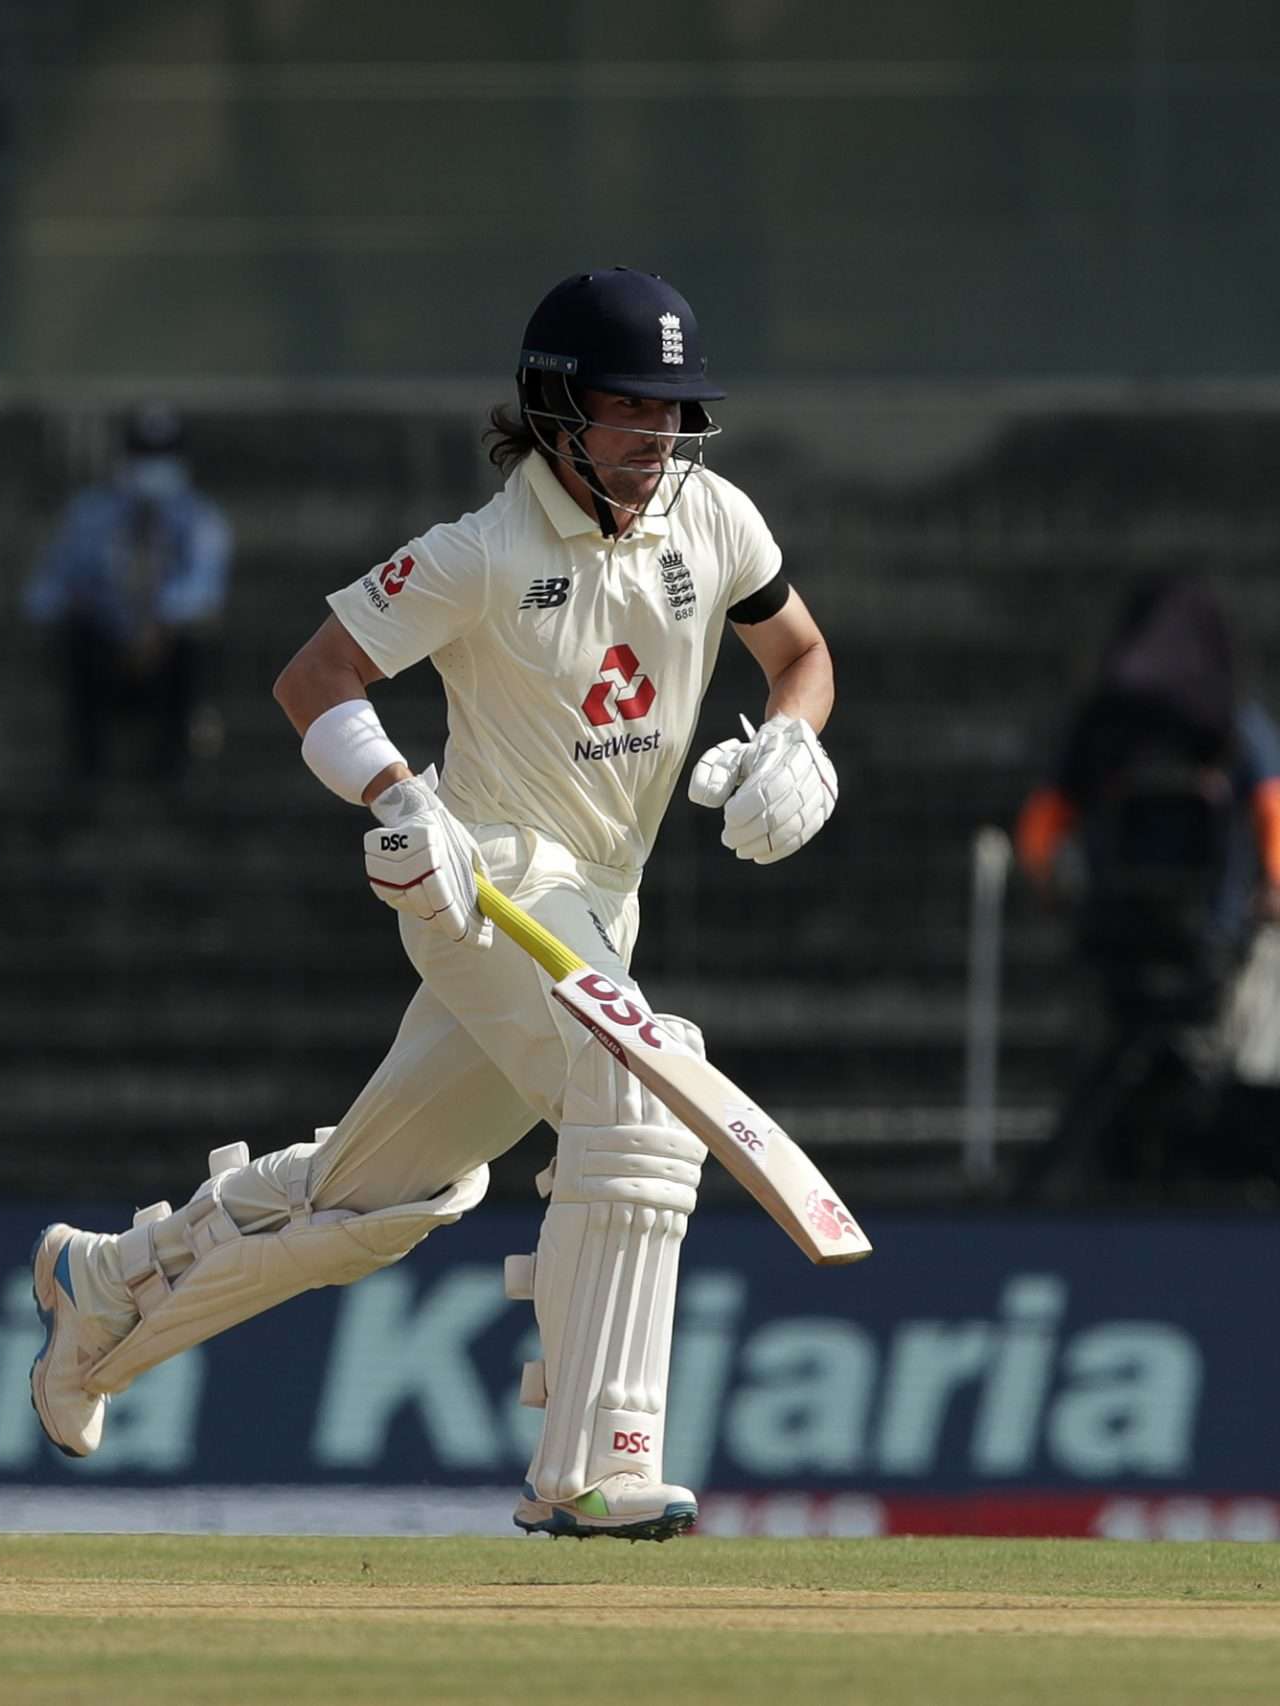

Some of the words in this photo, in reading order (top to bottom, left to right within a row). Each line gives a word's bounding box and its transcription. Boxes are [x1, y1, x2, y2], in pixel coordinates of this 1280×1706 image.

[674, 607, 694, 621] 688
[574, 729, 661, 761] NatWest
[381, 833, 409, 851] DSC
[576, 973, 662, 1049] DSC
[728, 1120, 764, 1151] DSC
[316, 1266, 1204, 1500] Kjaria
[612, 1432, 651, 1454] DSC
